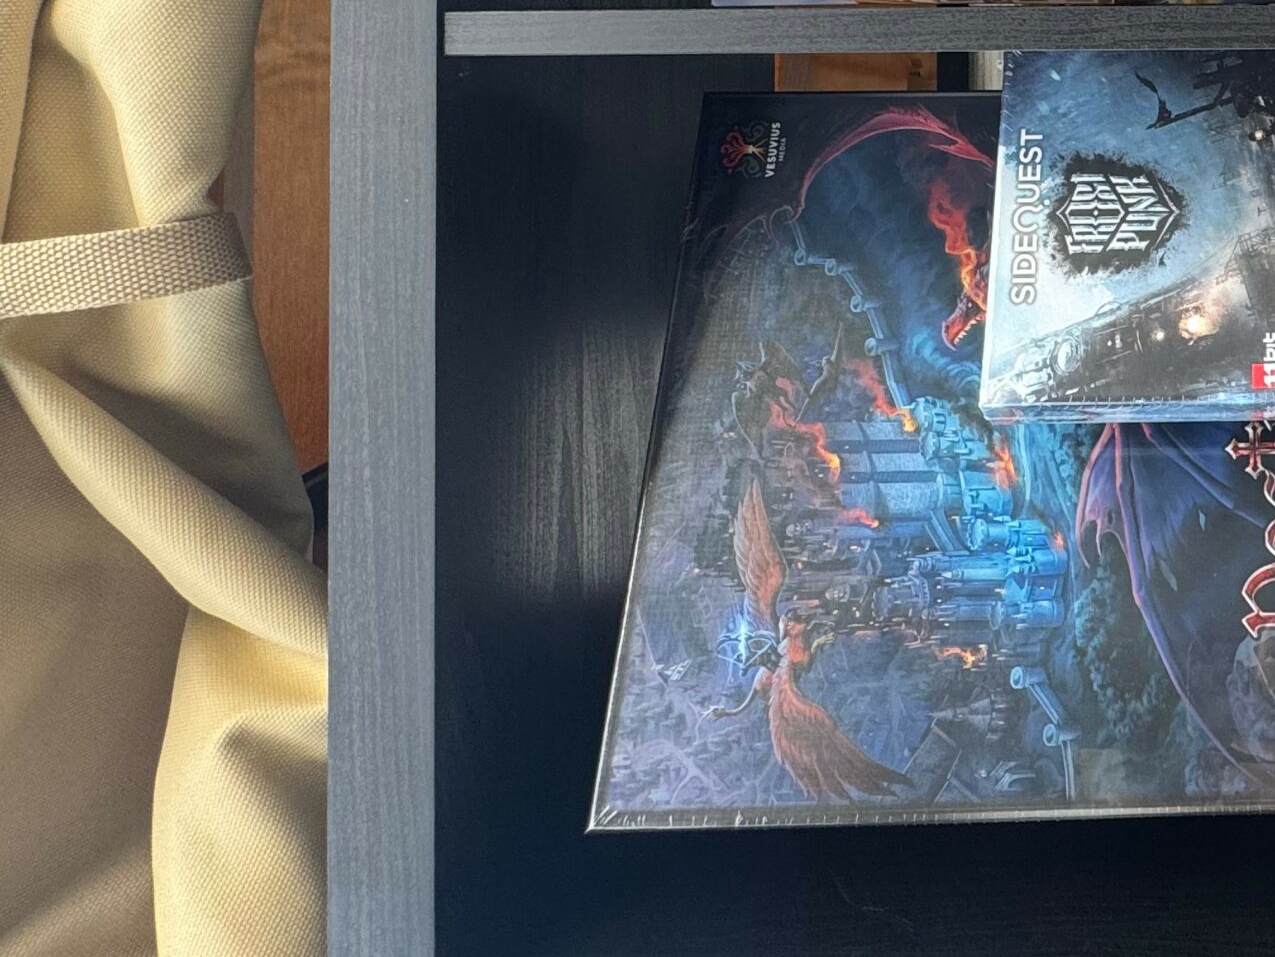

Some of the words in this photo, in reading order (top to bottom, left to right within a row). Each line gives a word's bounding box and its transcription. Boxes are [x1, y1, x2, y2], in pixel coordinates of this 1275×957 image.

[764, 122, 780, 177] VESUVIUS
[778, 137, 787, 162] MEDIA
[1010, 128, 1050, 305] SIDEQUEST
[1064, 172, 1125, 254] FROST
[1106, 173, 1170, 252] PUNK
